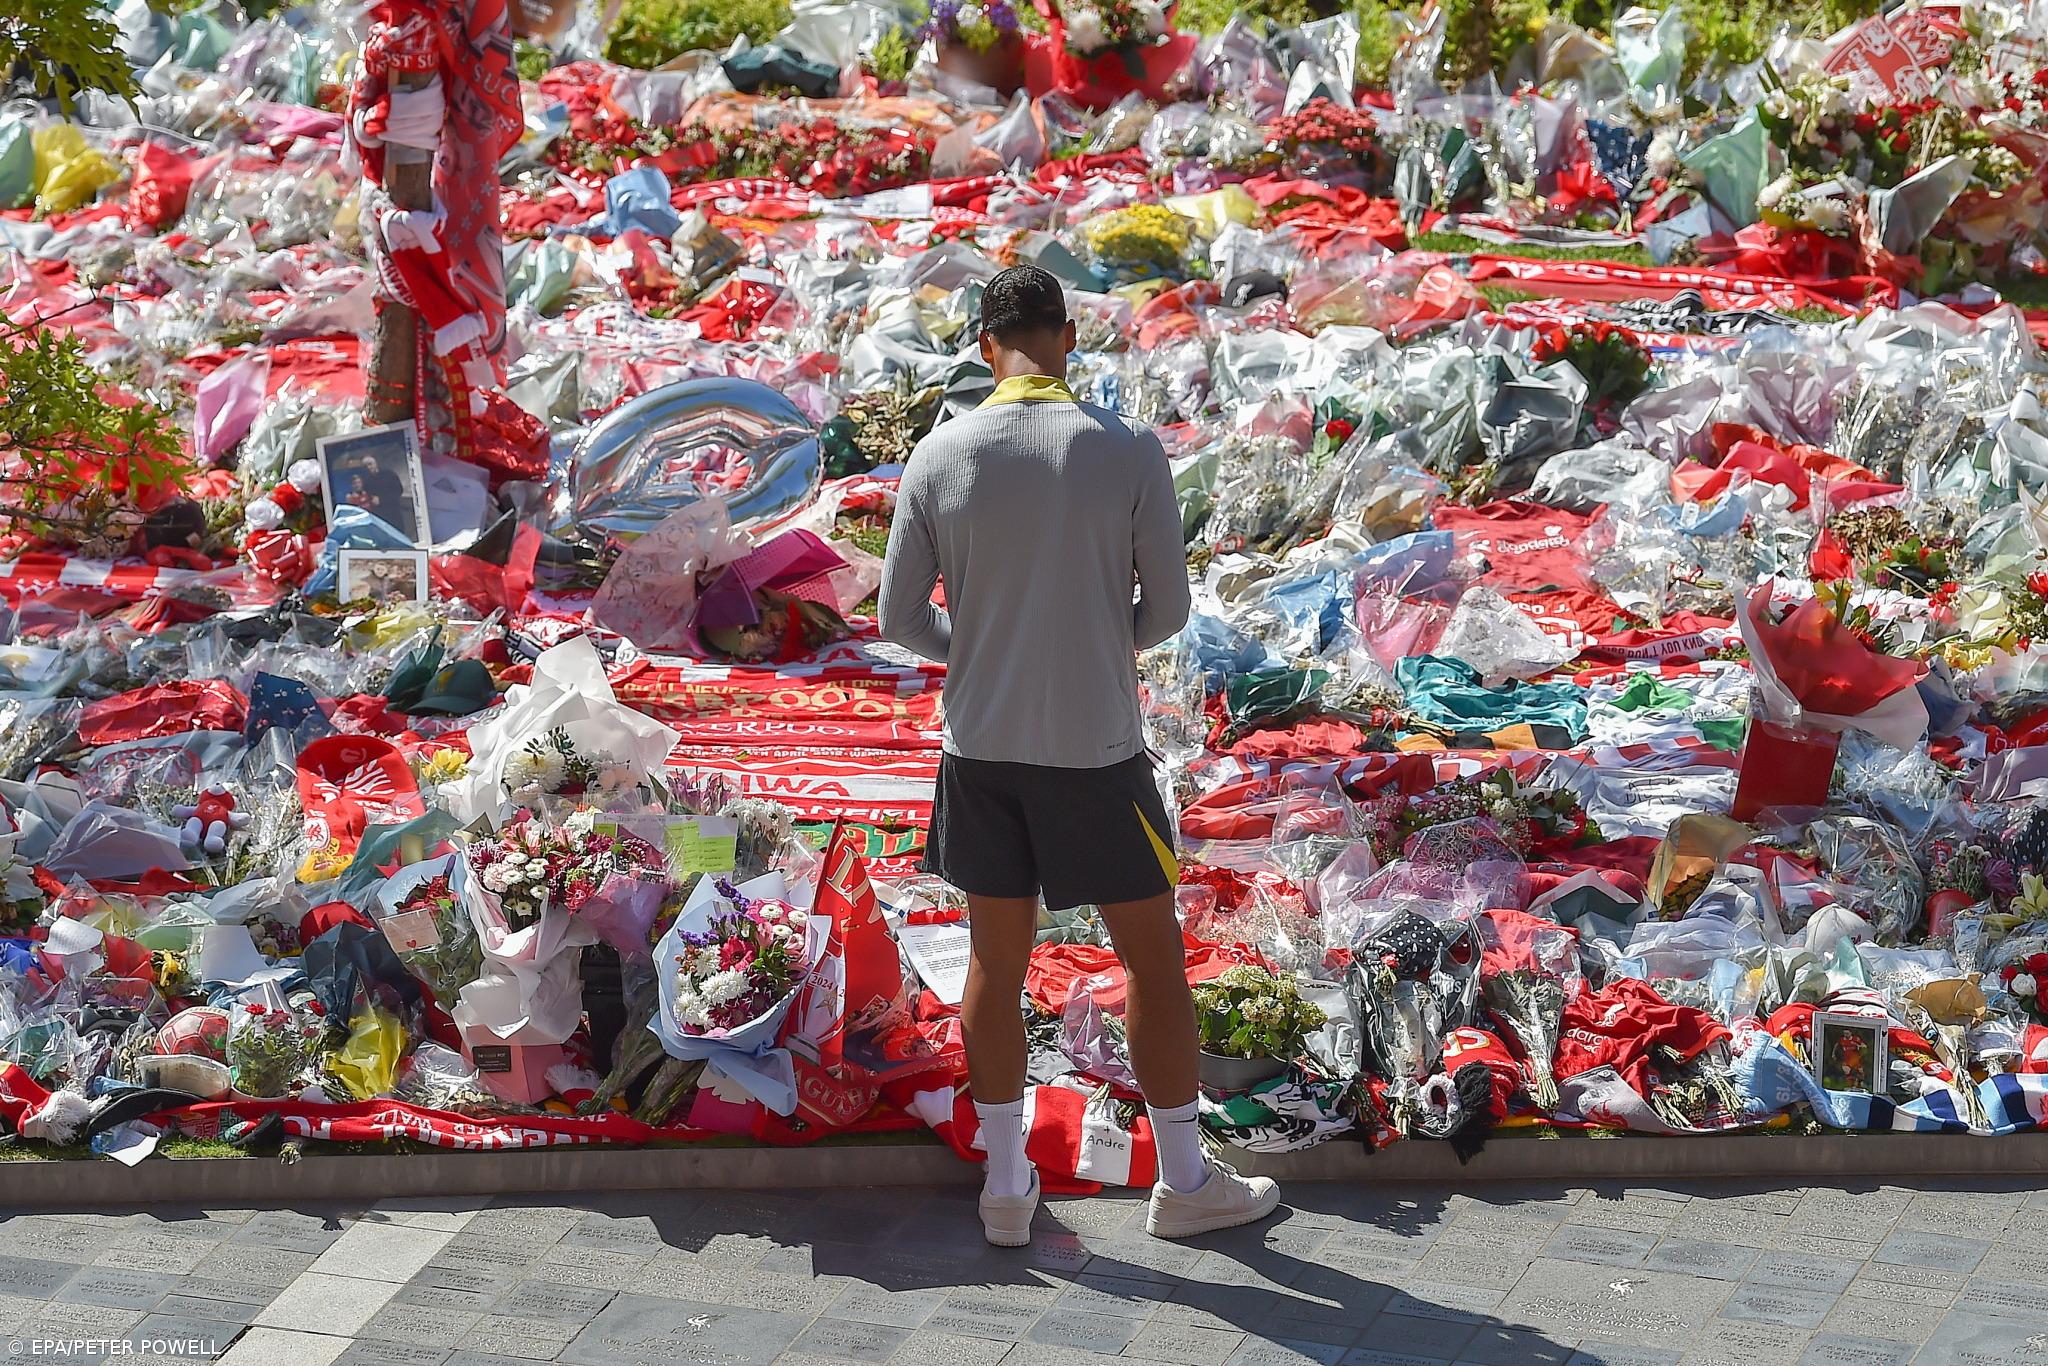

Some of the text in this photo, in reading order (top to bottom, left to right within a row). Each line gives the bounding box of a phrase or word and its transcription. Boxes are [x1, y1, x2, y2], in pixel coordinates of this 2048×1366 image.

[787, 805, 931, 826] ANFIEL
[811, 975, 834, 991] 2024
[374, 1109, 433, 1130] WALK
[1084, 1134, 1126, 1151] Andre
